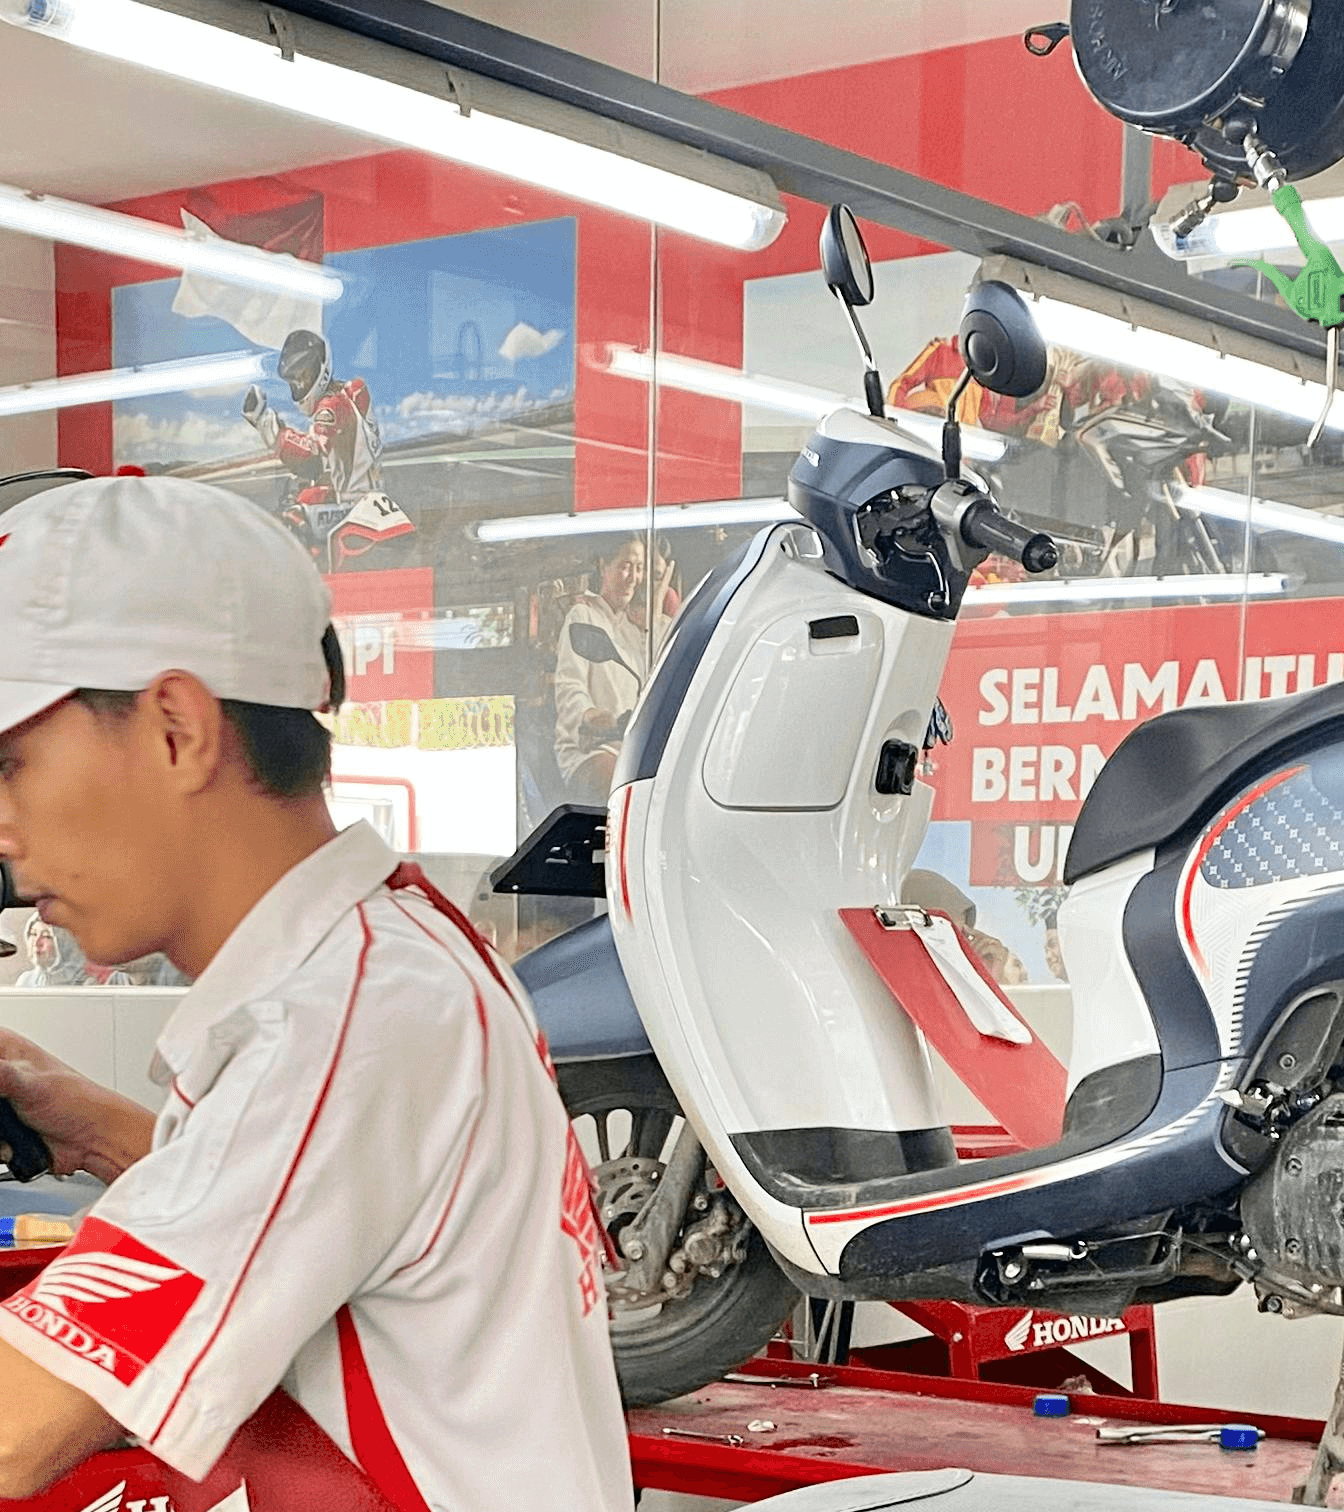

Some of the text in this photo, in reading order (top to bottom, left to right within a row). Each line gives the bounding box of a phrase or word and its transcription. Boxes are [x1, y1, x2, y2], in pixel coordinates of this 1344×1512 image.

[372, 496, 400, 517] 12
[978, 659, 1230, 727] SELAMA
[3, 1296, 116, 1374] HONDA
[1032, 1315, 1126, 1347] HONDA
